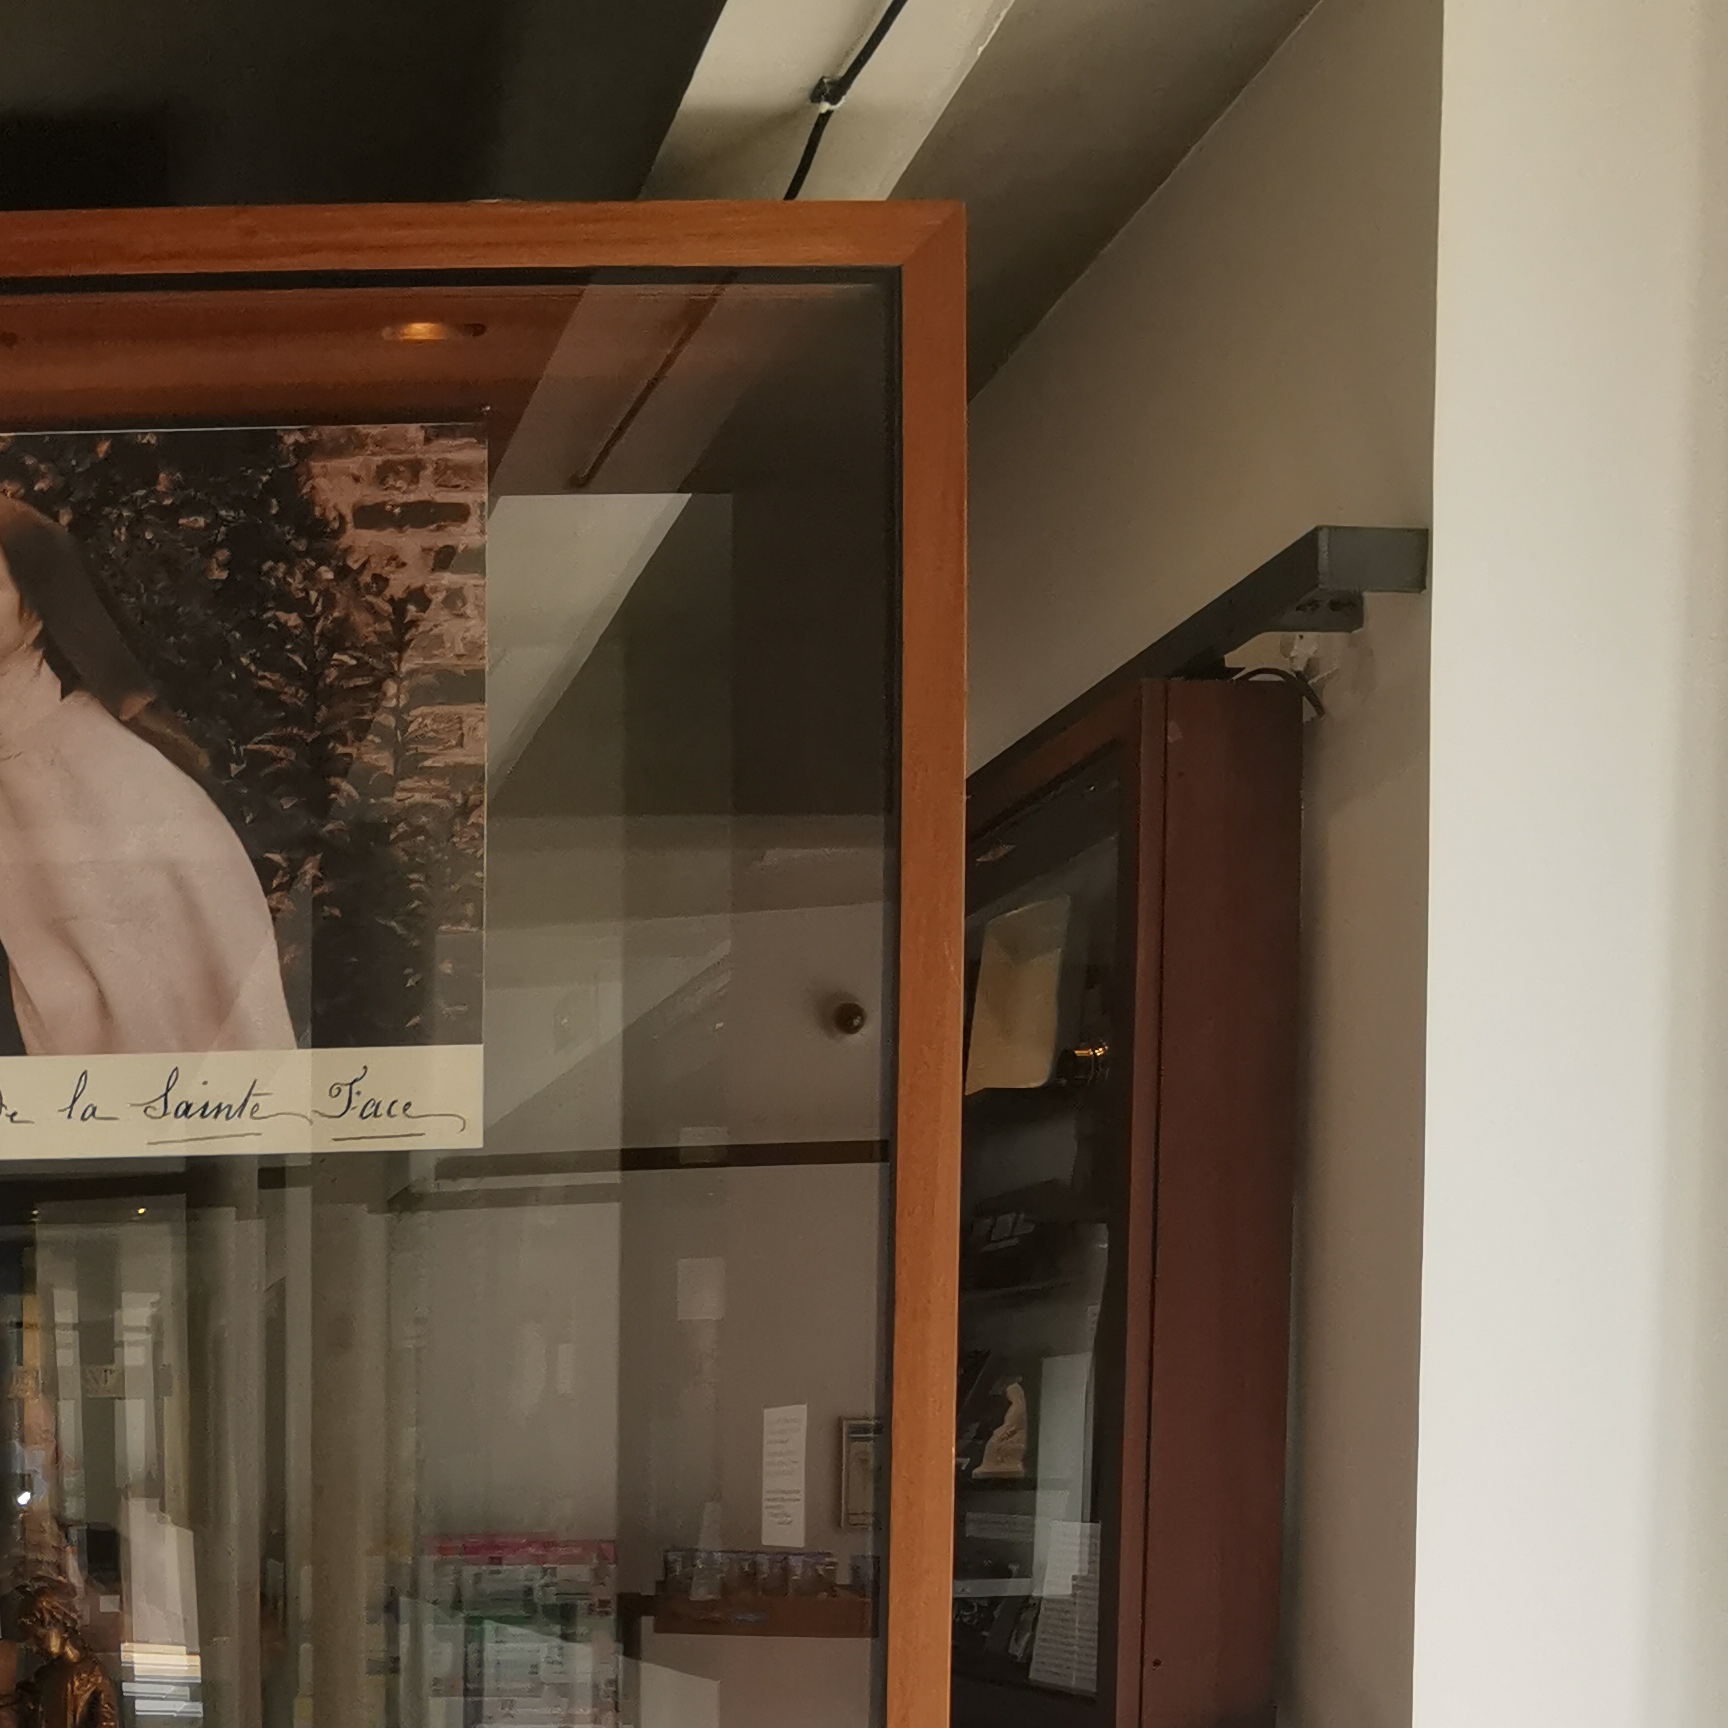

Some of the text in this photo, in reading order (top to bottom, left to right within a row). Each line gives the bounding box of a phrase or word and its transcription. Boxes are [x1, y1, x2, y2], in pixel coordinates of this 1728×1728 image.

[57, 1070, 119, 1122] la
[130, 1066, 313, 1126] Sainte
[322, 1066, 467, 1134] Face
